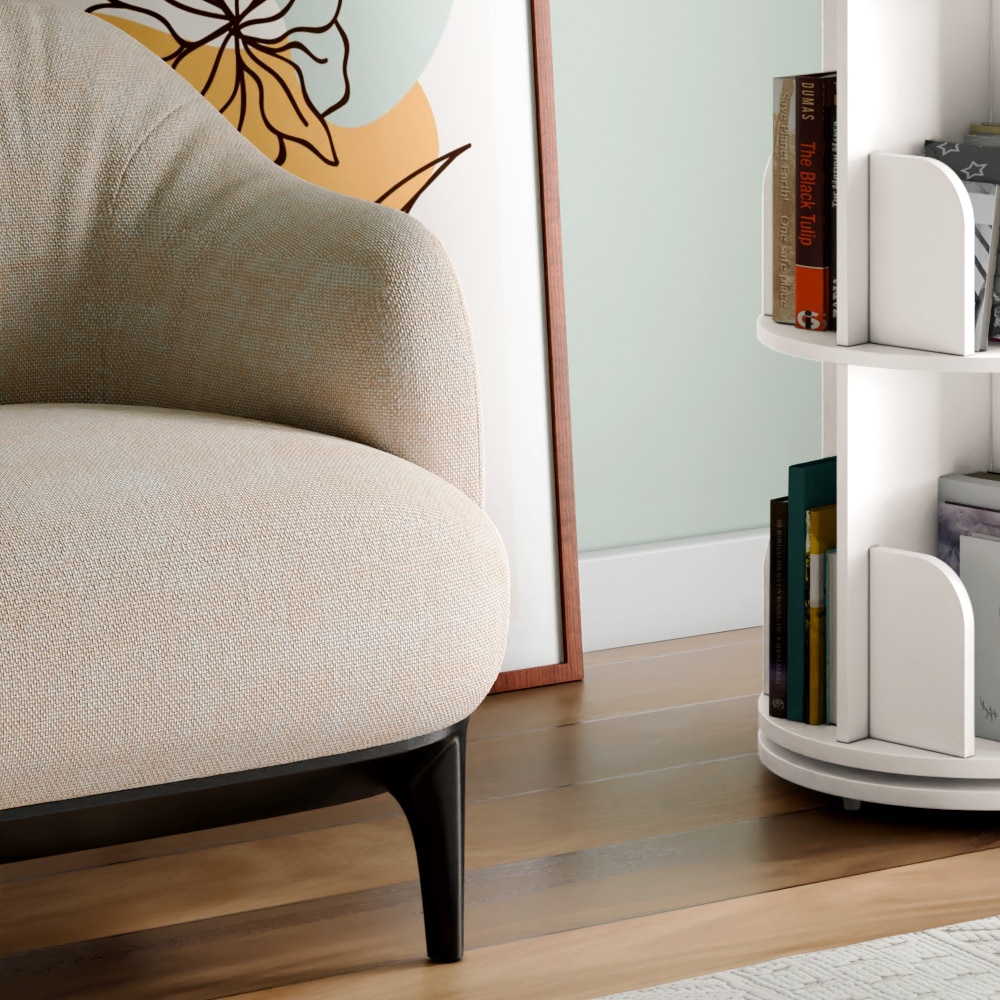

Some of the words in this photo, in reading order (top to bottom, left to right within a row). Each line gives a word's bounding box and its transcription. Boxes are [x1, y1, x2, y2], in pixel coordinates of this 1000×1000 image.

[780, 91, 790, 121] Save
[802, 82, 815, 120] DUMAS
[780, 124, 790, 161] Planet
[800, 142, 816, 166] The
[779, 166, 790, 201] Earth!
[800, 170, 816, 209] Black
[779, 215, 790, 241] One
[797, 214, 816, 246] Tulip
[779, 244, 790, 271] safe
[778, 274, 790, 308] place
